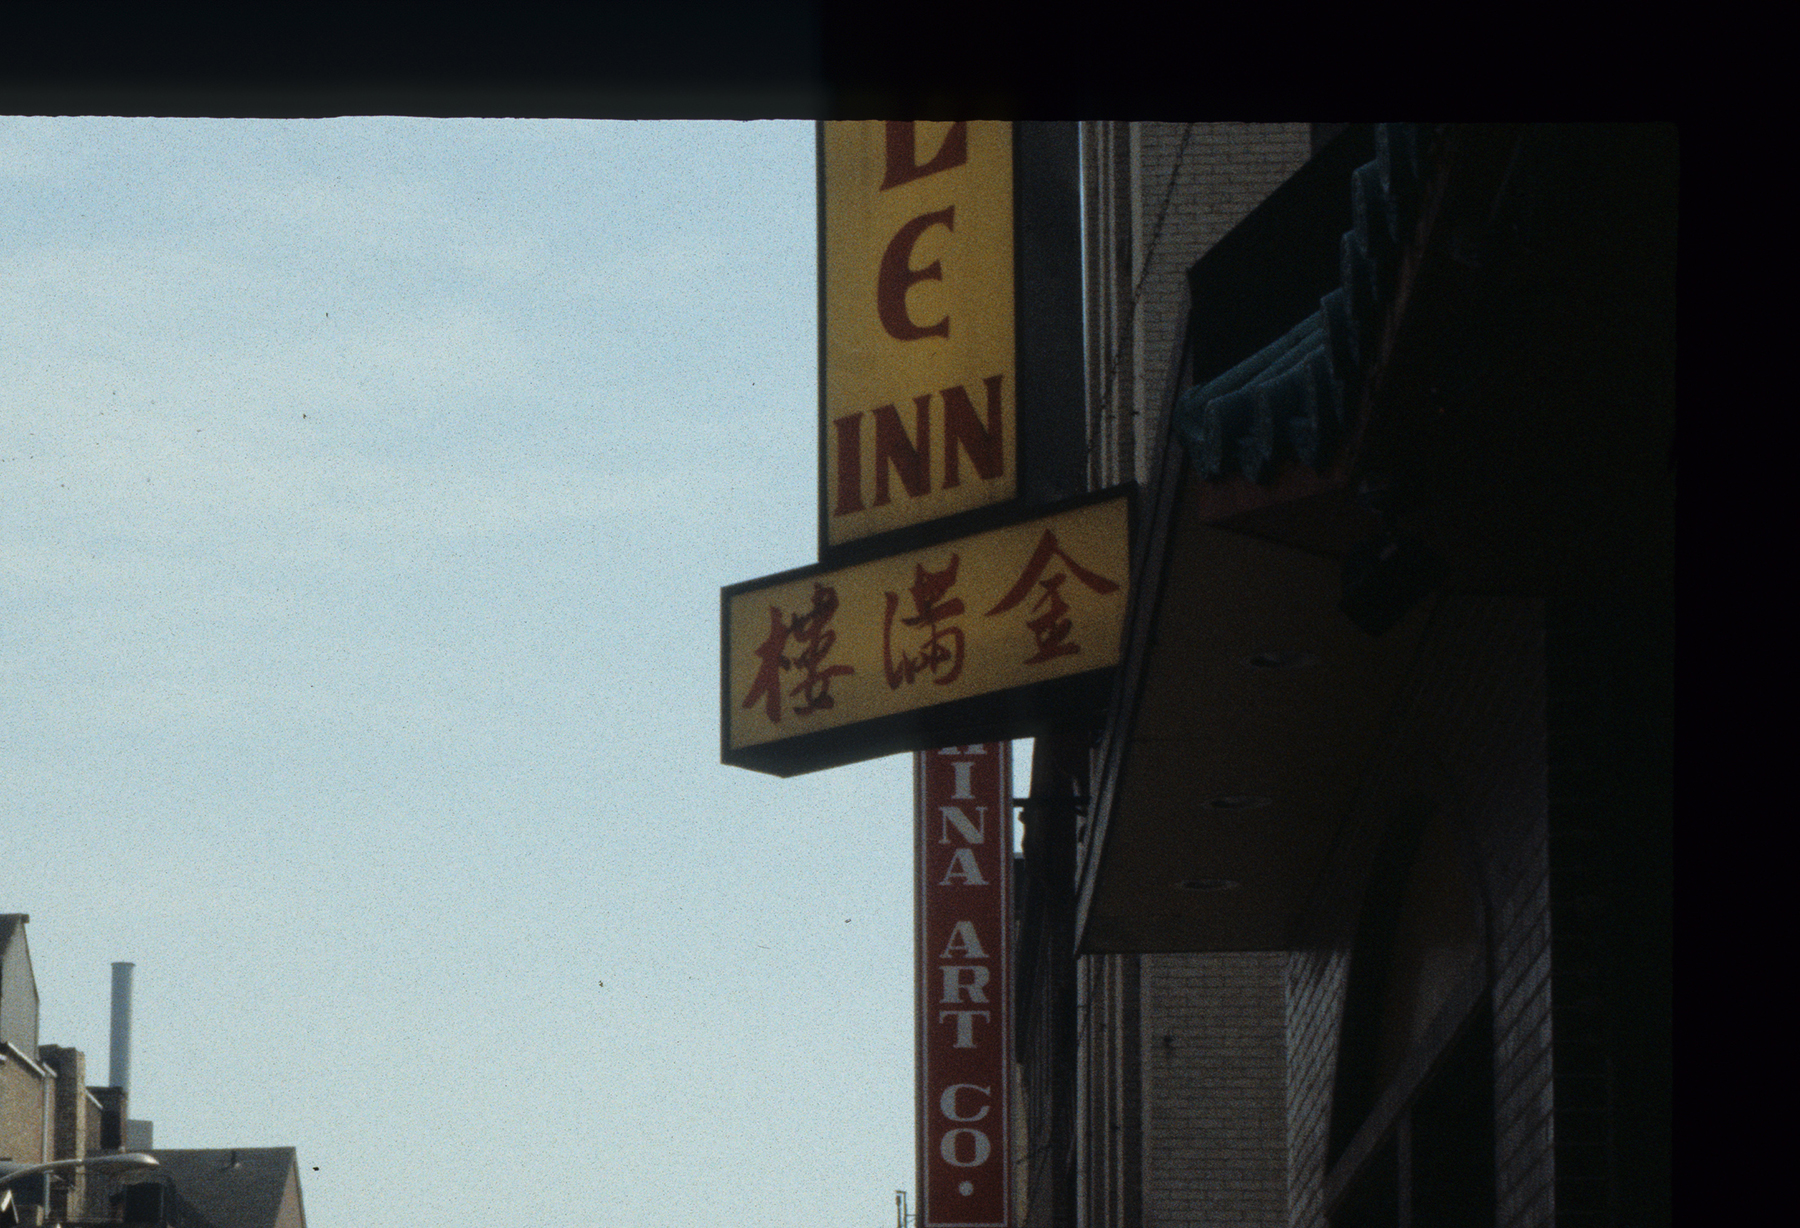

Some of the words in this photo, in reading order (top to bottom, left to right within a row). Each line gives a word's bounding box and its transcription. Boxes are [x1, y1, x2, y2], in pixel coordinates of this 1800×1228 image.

[833, 375, 1006, 518] INN
[938, 742, 989, 887] INA
[939, 919, 991, 1050] ART
[940, 1082, 993, 1198] CO.
